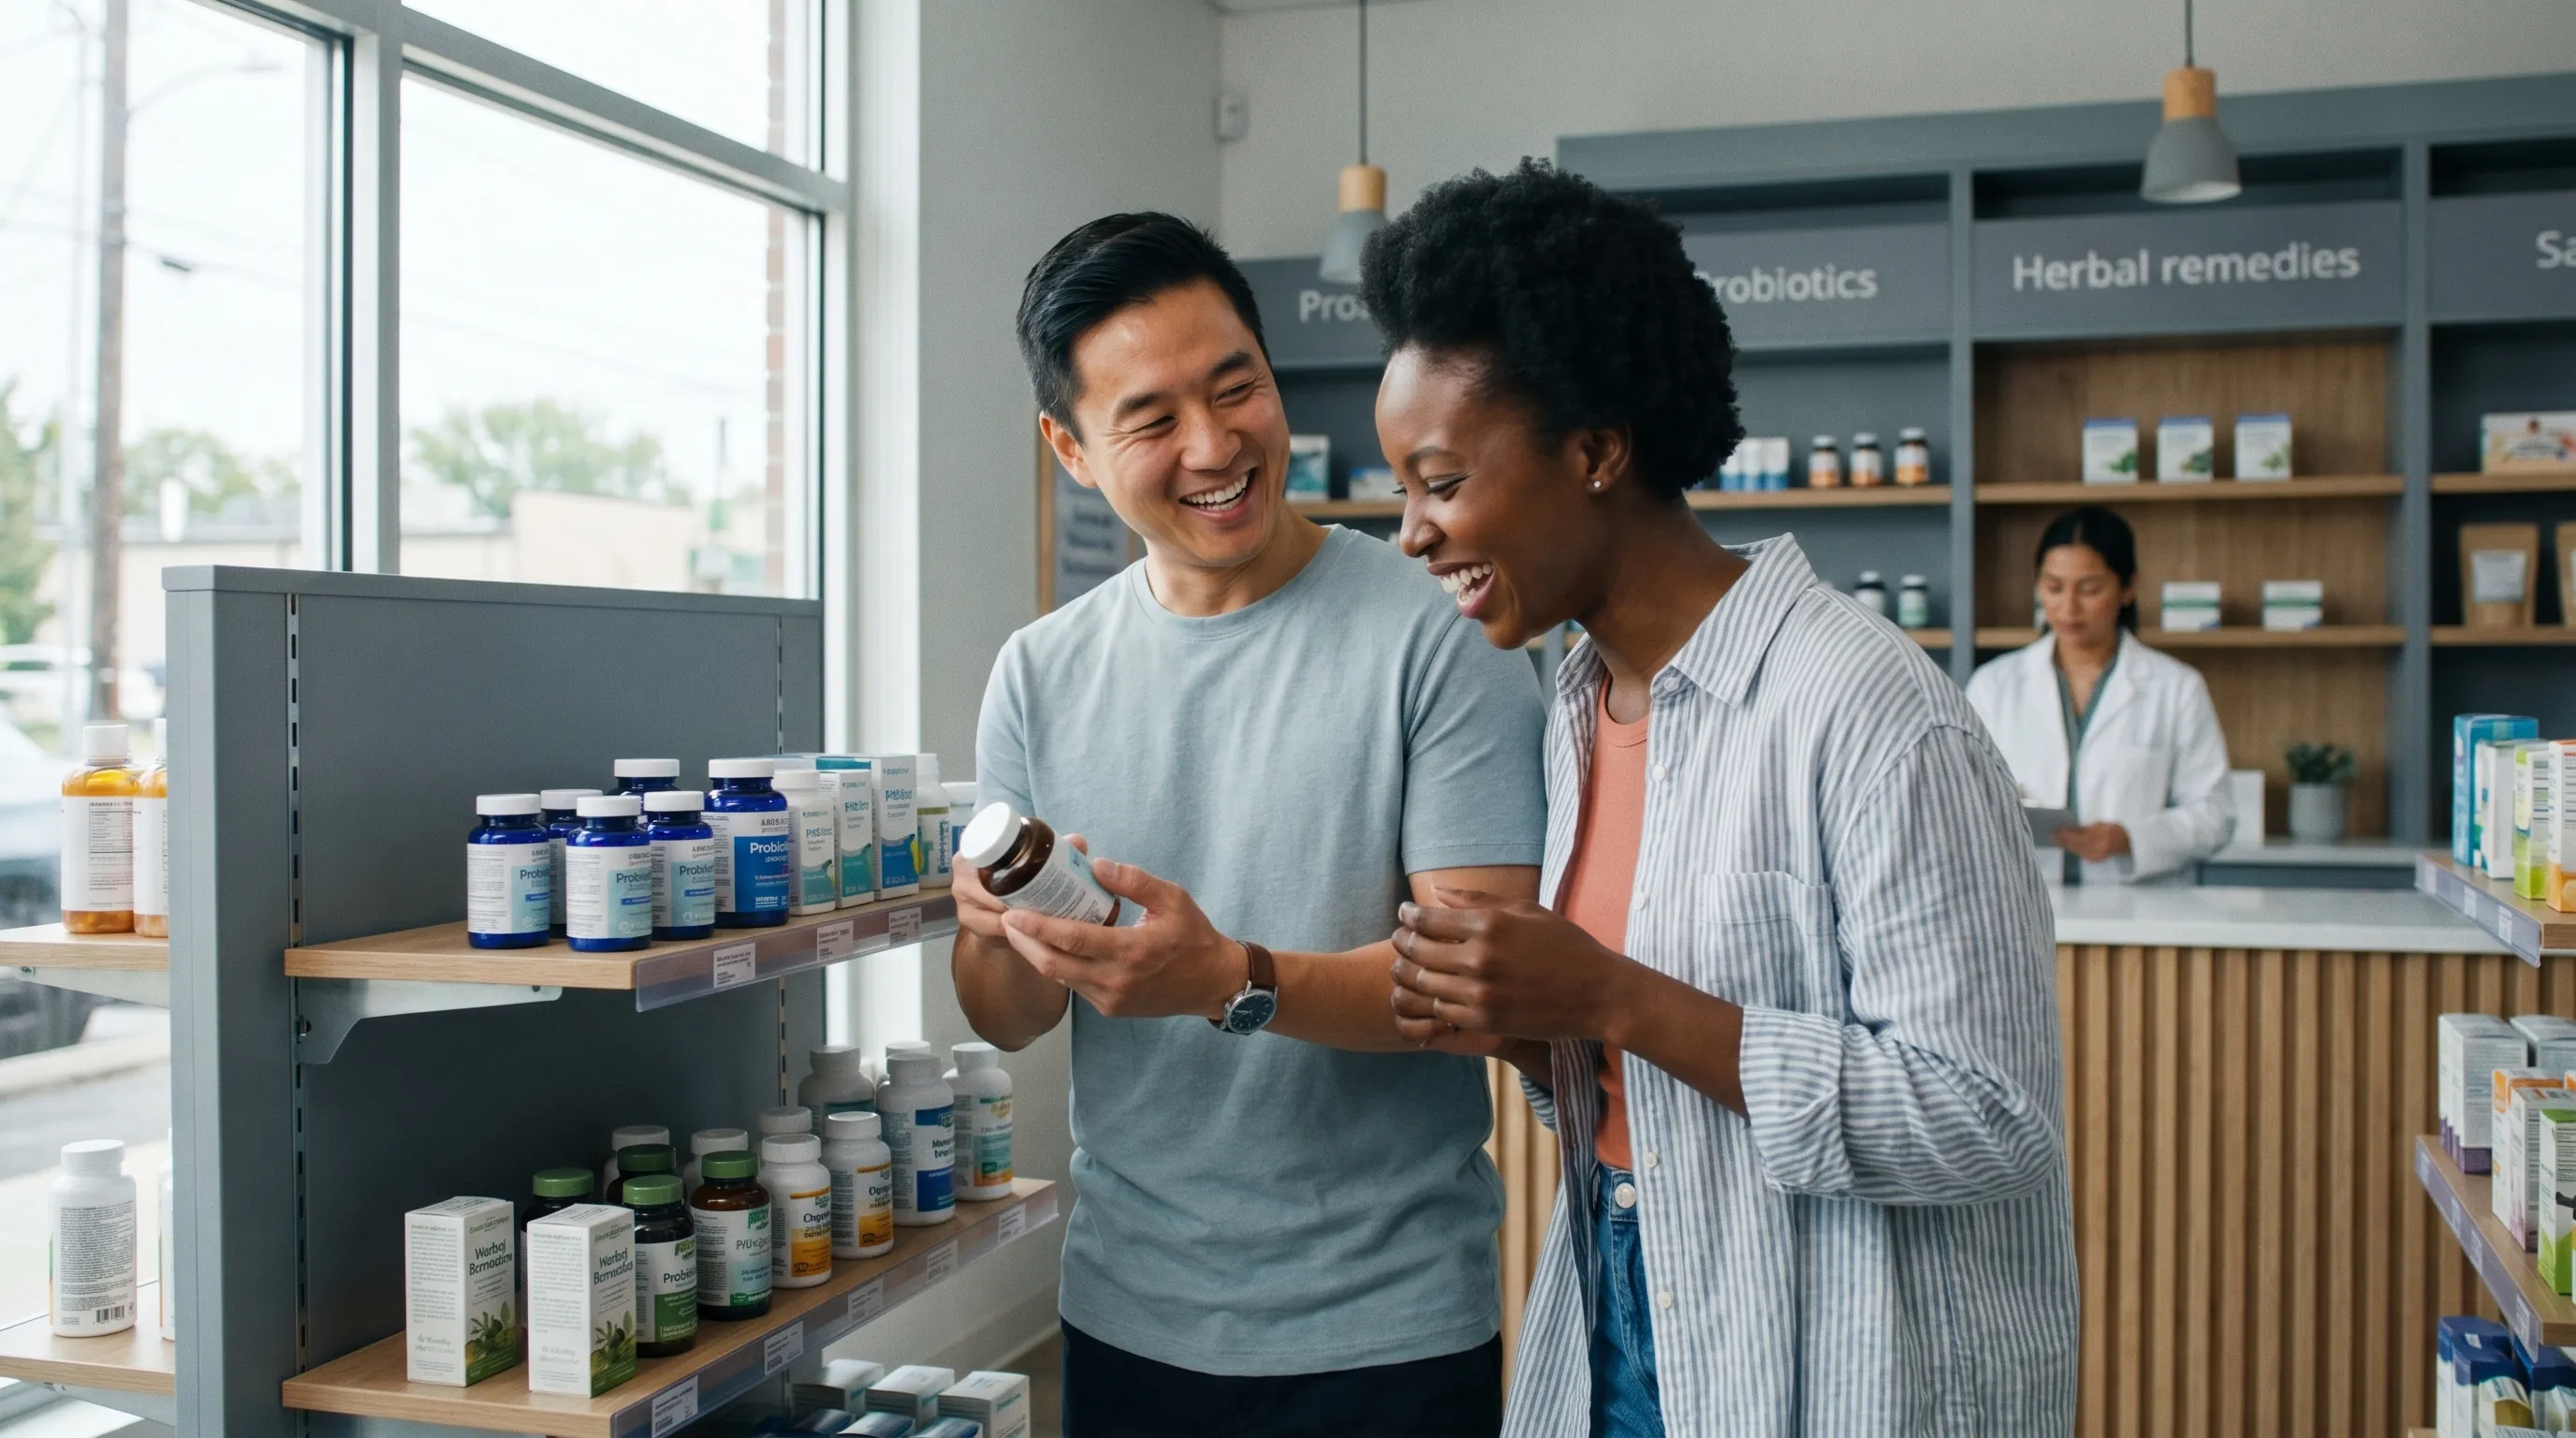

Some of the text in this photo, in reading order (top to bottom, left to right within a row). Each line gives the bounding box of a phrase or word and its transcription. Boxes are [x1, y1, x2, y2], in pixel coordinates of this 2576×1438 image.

[1694, 263, 1879, 304] robiotics
[2012, 242, 2361, 291] Herbal remedies
